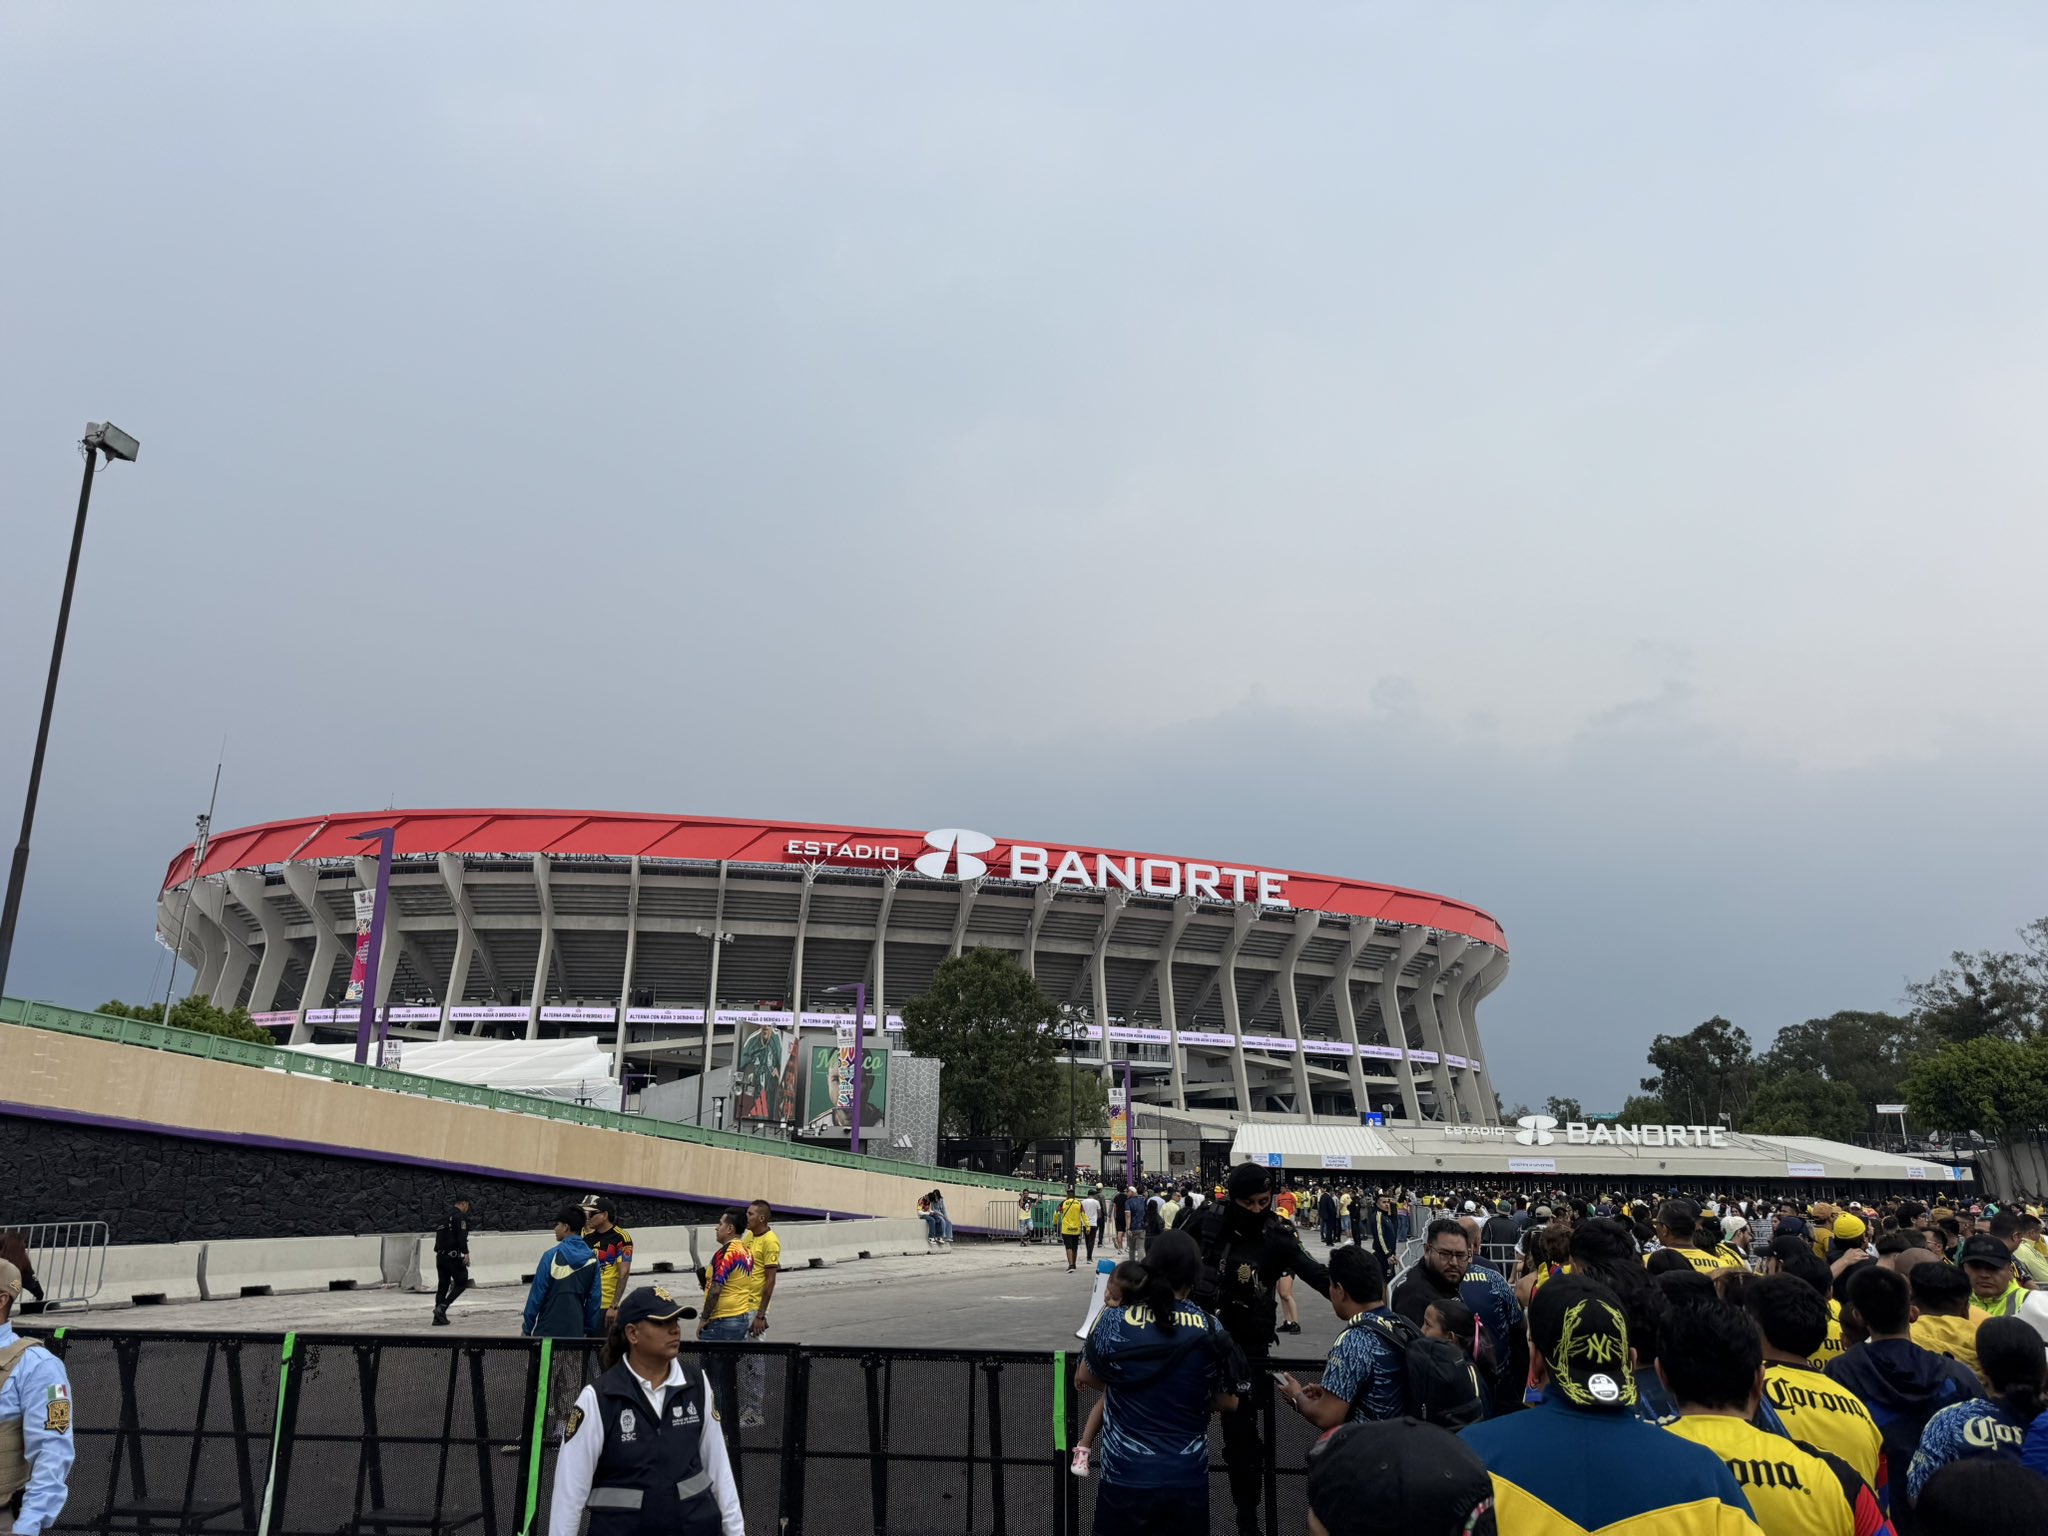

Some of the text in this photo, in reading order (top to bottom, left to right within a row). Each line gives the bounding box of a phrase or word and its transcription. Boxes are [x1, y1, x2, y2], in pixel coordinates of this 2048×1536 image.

[788, 839, 1290, 907] ESTADIO BANORTE
[1444, 1122, 1729, 1147] ESTADIO BANORTE
[1463, 1272, 1487, 1282] ona
[1586, 1333, 1612, 1364] NY
[1762, 1377, 1869, 1421] Corona
[621, 1432, 637, 1442] SSC
[1963, 1415, 2023, 1451] Cor
[1727, 1458, 1803, 1490] ona
